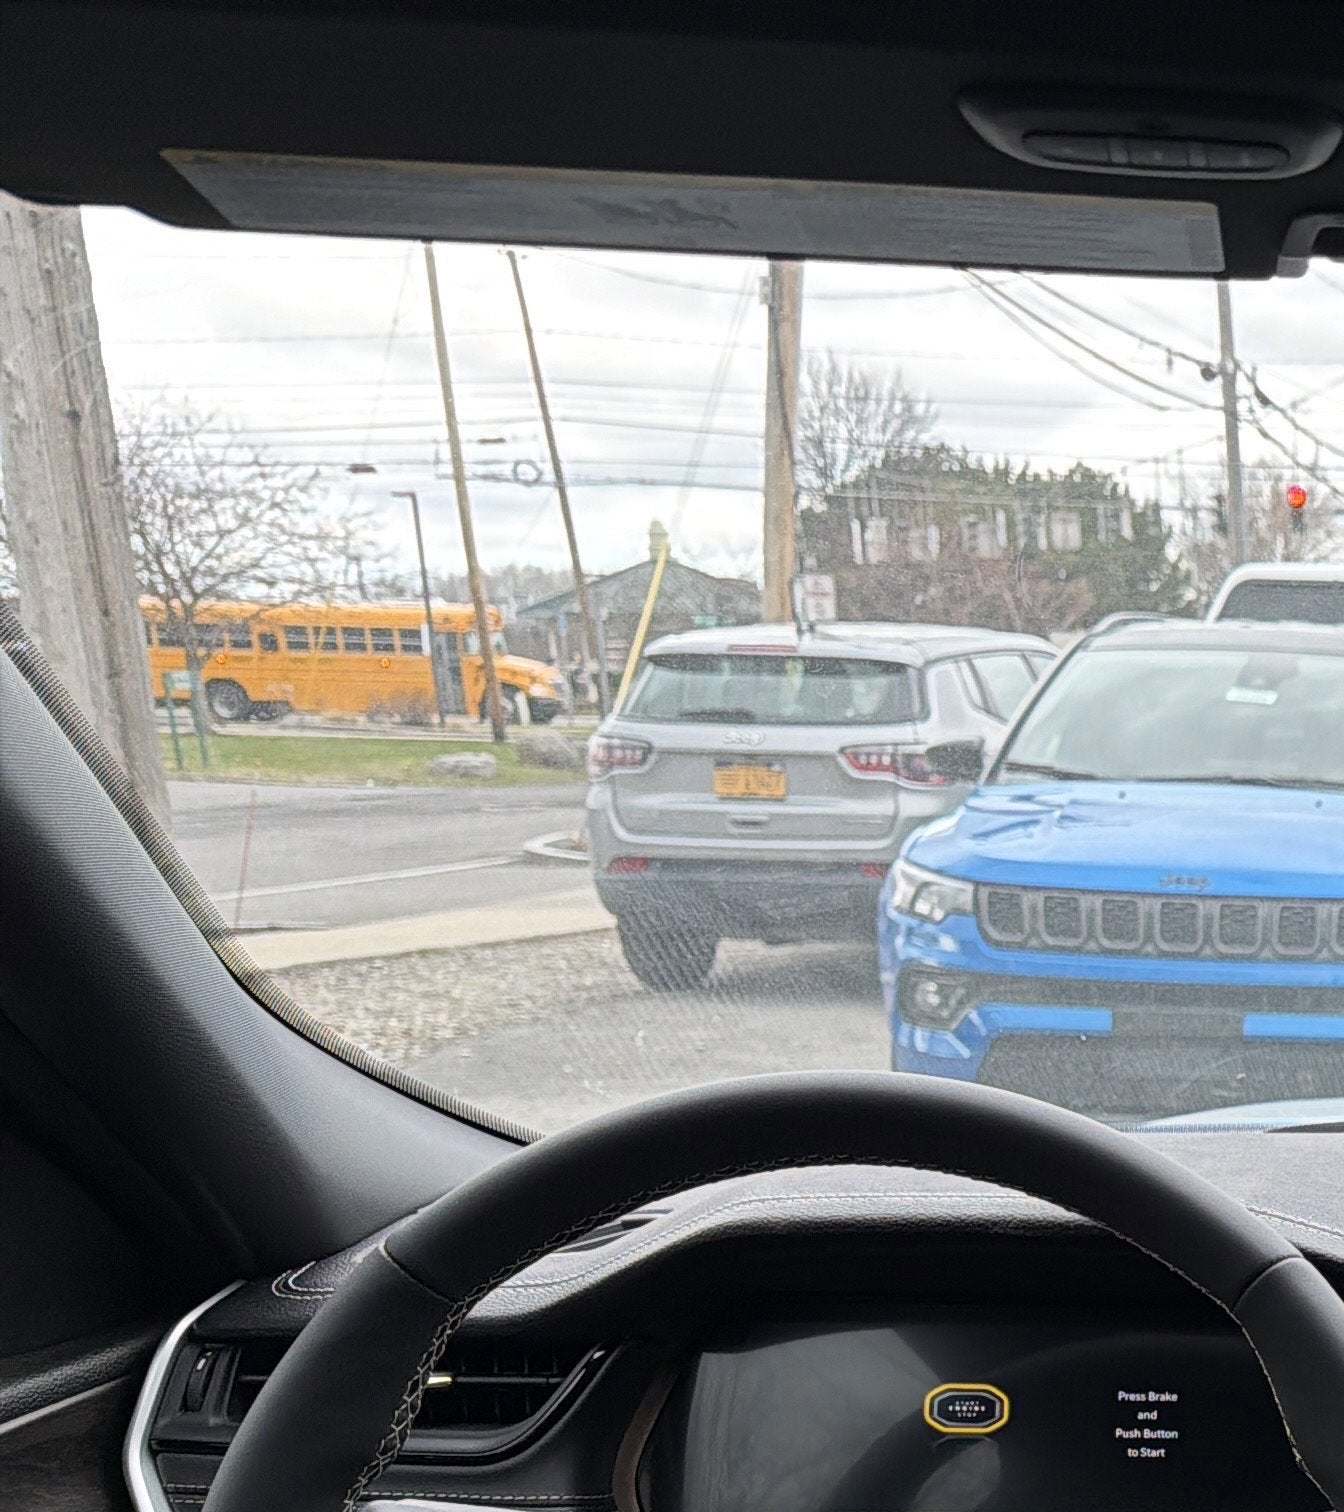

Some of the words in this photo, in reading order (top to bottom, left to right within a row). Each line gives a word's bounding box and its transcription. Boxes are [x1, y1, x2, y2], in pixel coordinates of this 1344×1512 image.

[1118, 1391, 1146, 1402] Press
[1148, 1391, 1179, 1402] Brake
[1137, 1409, 1158, 1420] and
[1115, 1427, 1141, 1439] Push
[1143, 1428, 1179, 1439] Button
[1127, 1447, 1139, 1458] to
[1140, 1446, 1167, 1458] Start
